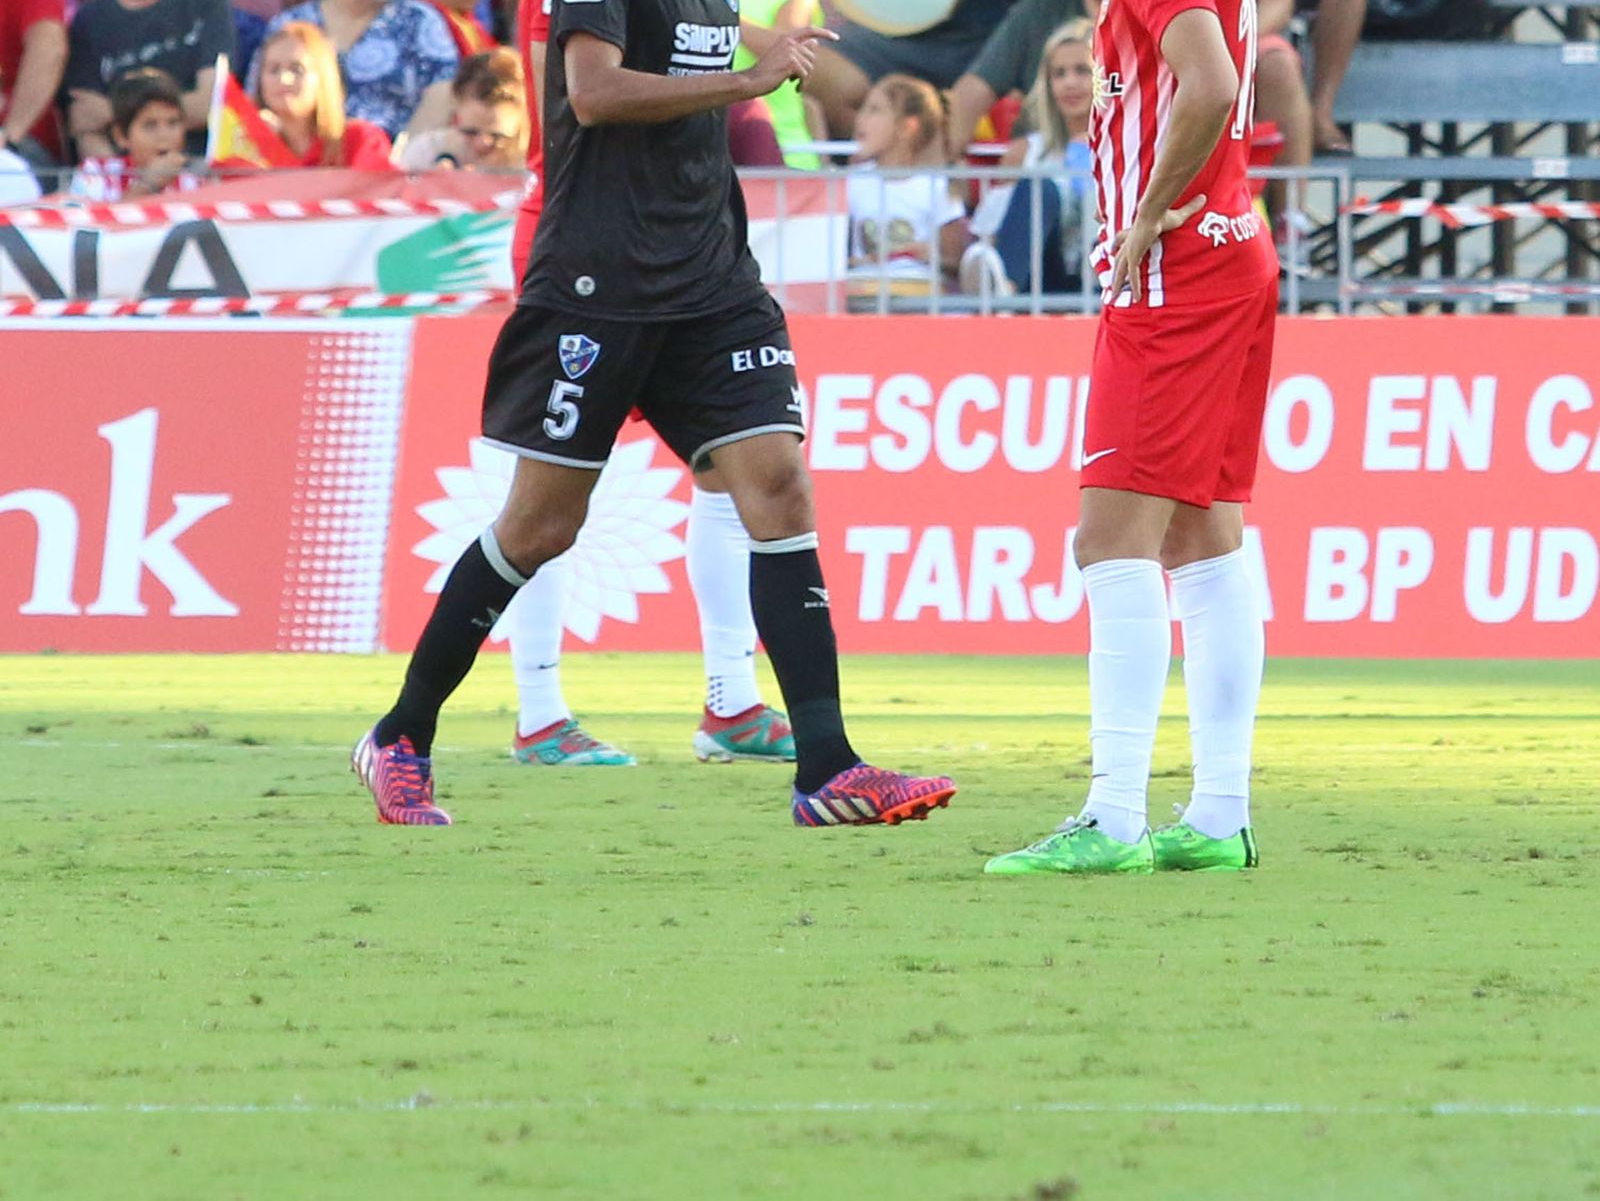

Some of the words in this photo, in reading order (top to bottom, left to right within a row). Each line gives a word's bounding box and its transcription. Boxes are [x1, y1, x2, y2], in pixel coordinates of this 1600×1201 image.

[543, 379, 584, 441] 5
[800, 373, 1335, 473] ESCUO
[1363, 375, 1497, 472] EN
[1525, 374, 1600, 473] C
[845, 526, 1275, 623] TARJ
[1304, 527, 1434, 623] BP
[1464, 527, 1600, 624] UD
